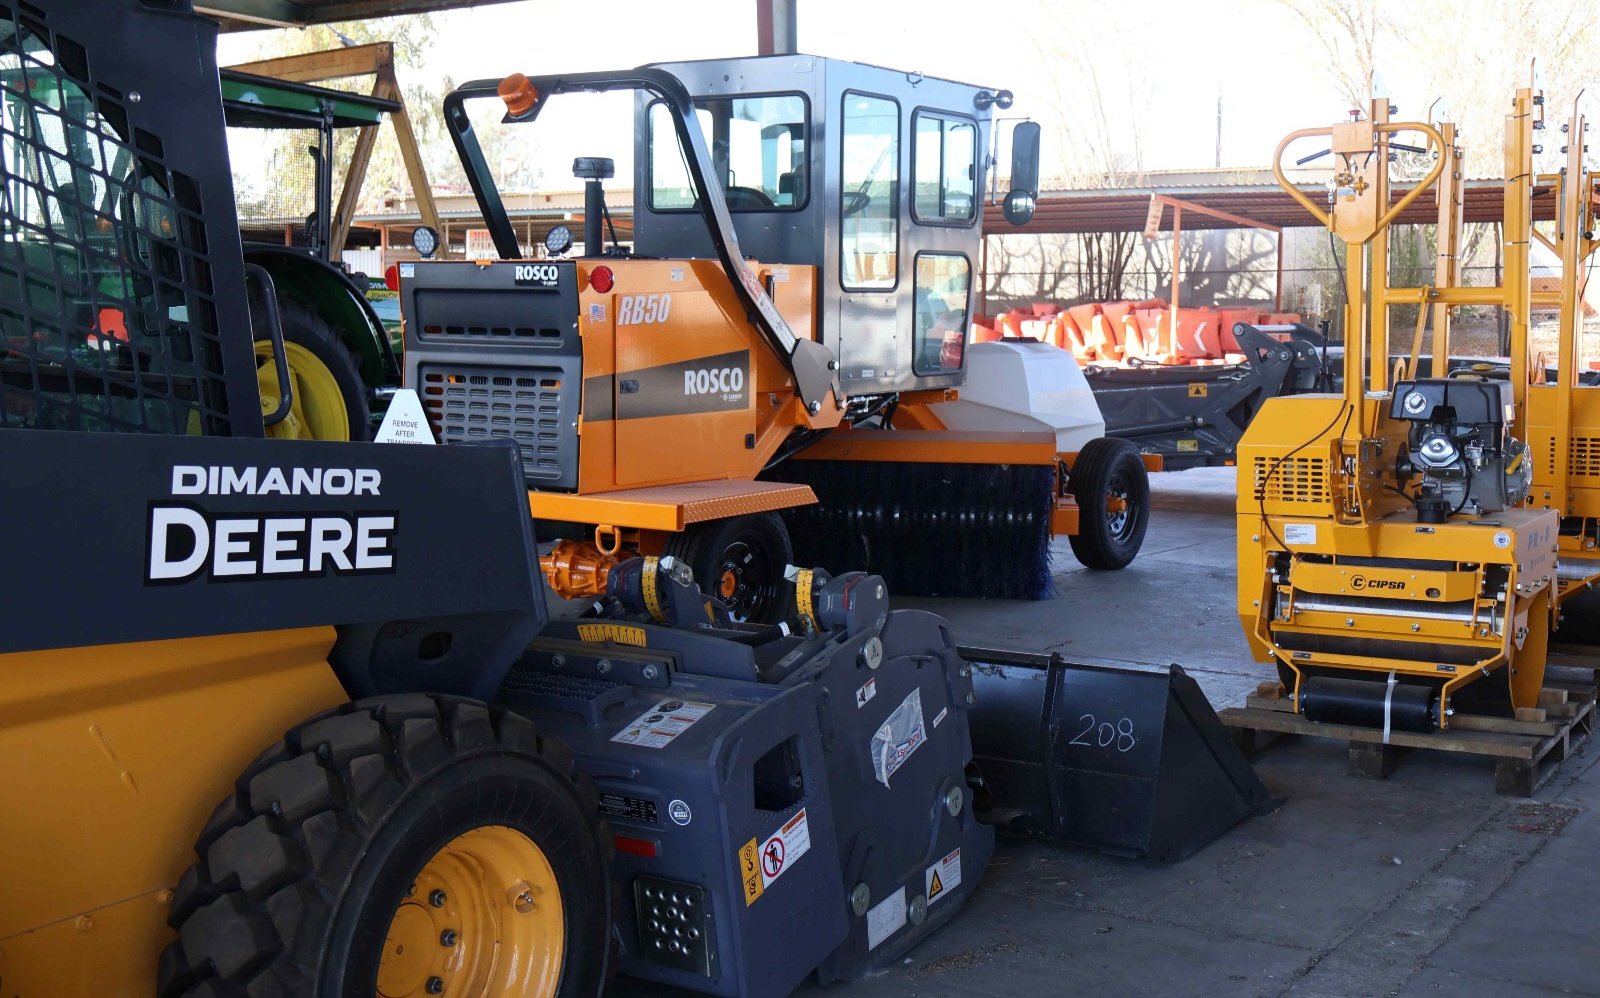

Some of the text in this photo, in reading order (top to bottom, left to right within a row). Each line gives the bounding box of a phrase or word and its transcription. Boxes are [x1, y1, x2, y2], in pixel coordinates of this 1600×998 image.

[515, 265, 558, 280] ROSCO
[617, 293, 671, 326] RB50
[684, 367, 743, 396] ROSCO
[392, 419, 419, 428] REMOVE
[395, 429, 415, 438] AFTER
[172, 465, 381, 495] DIMANOR
[150, 507, 395, 579] DEERE
[1368, 579, 1406, 590] CIPSA
[1068, 713, 1135, 752] 208
